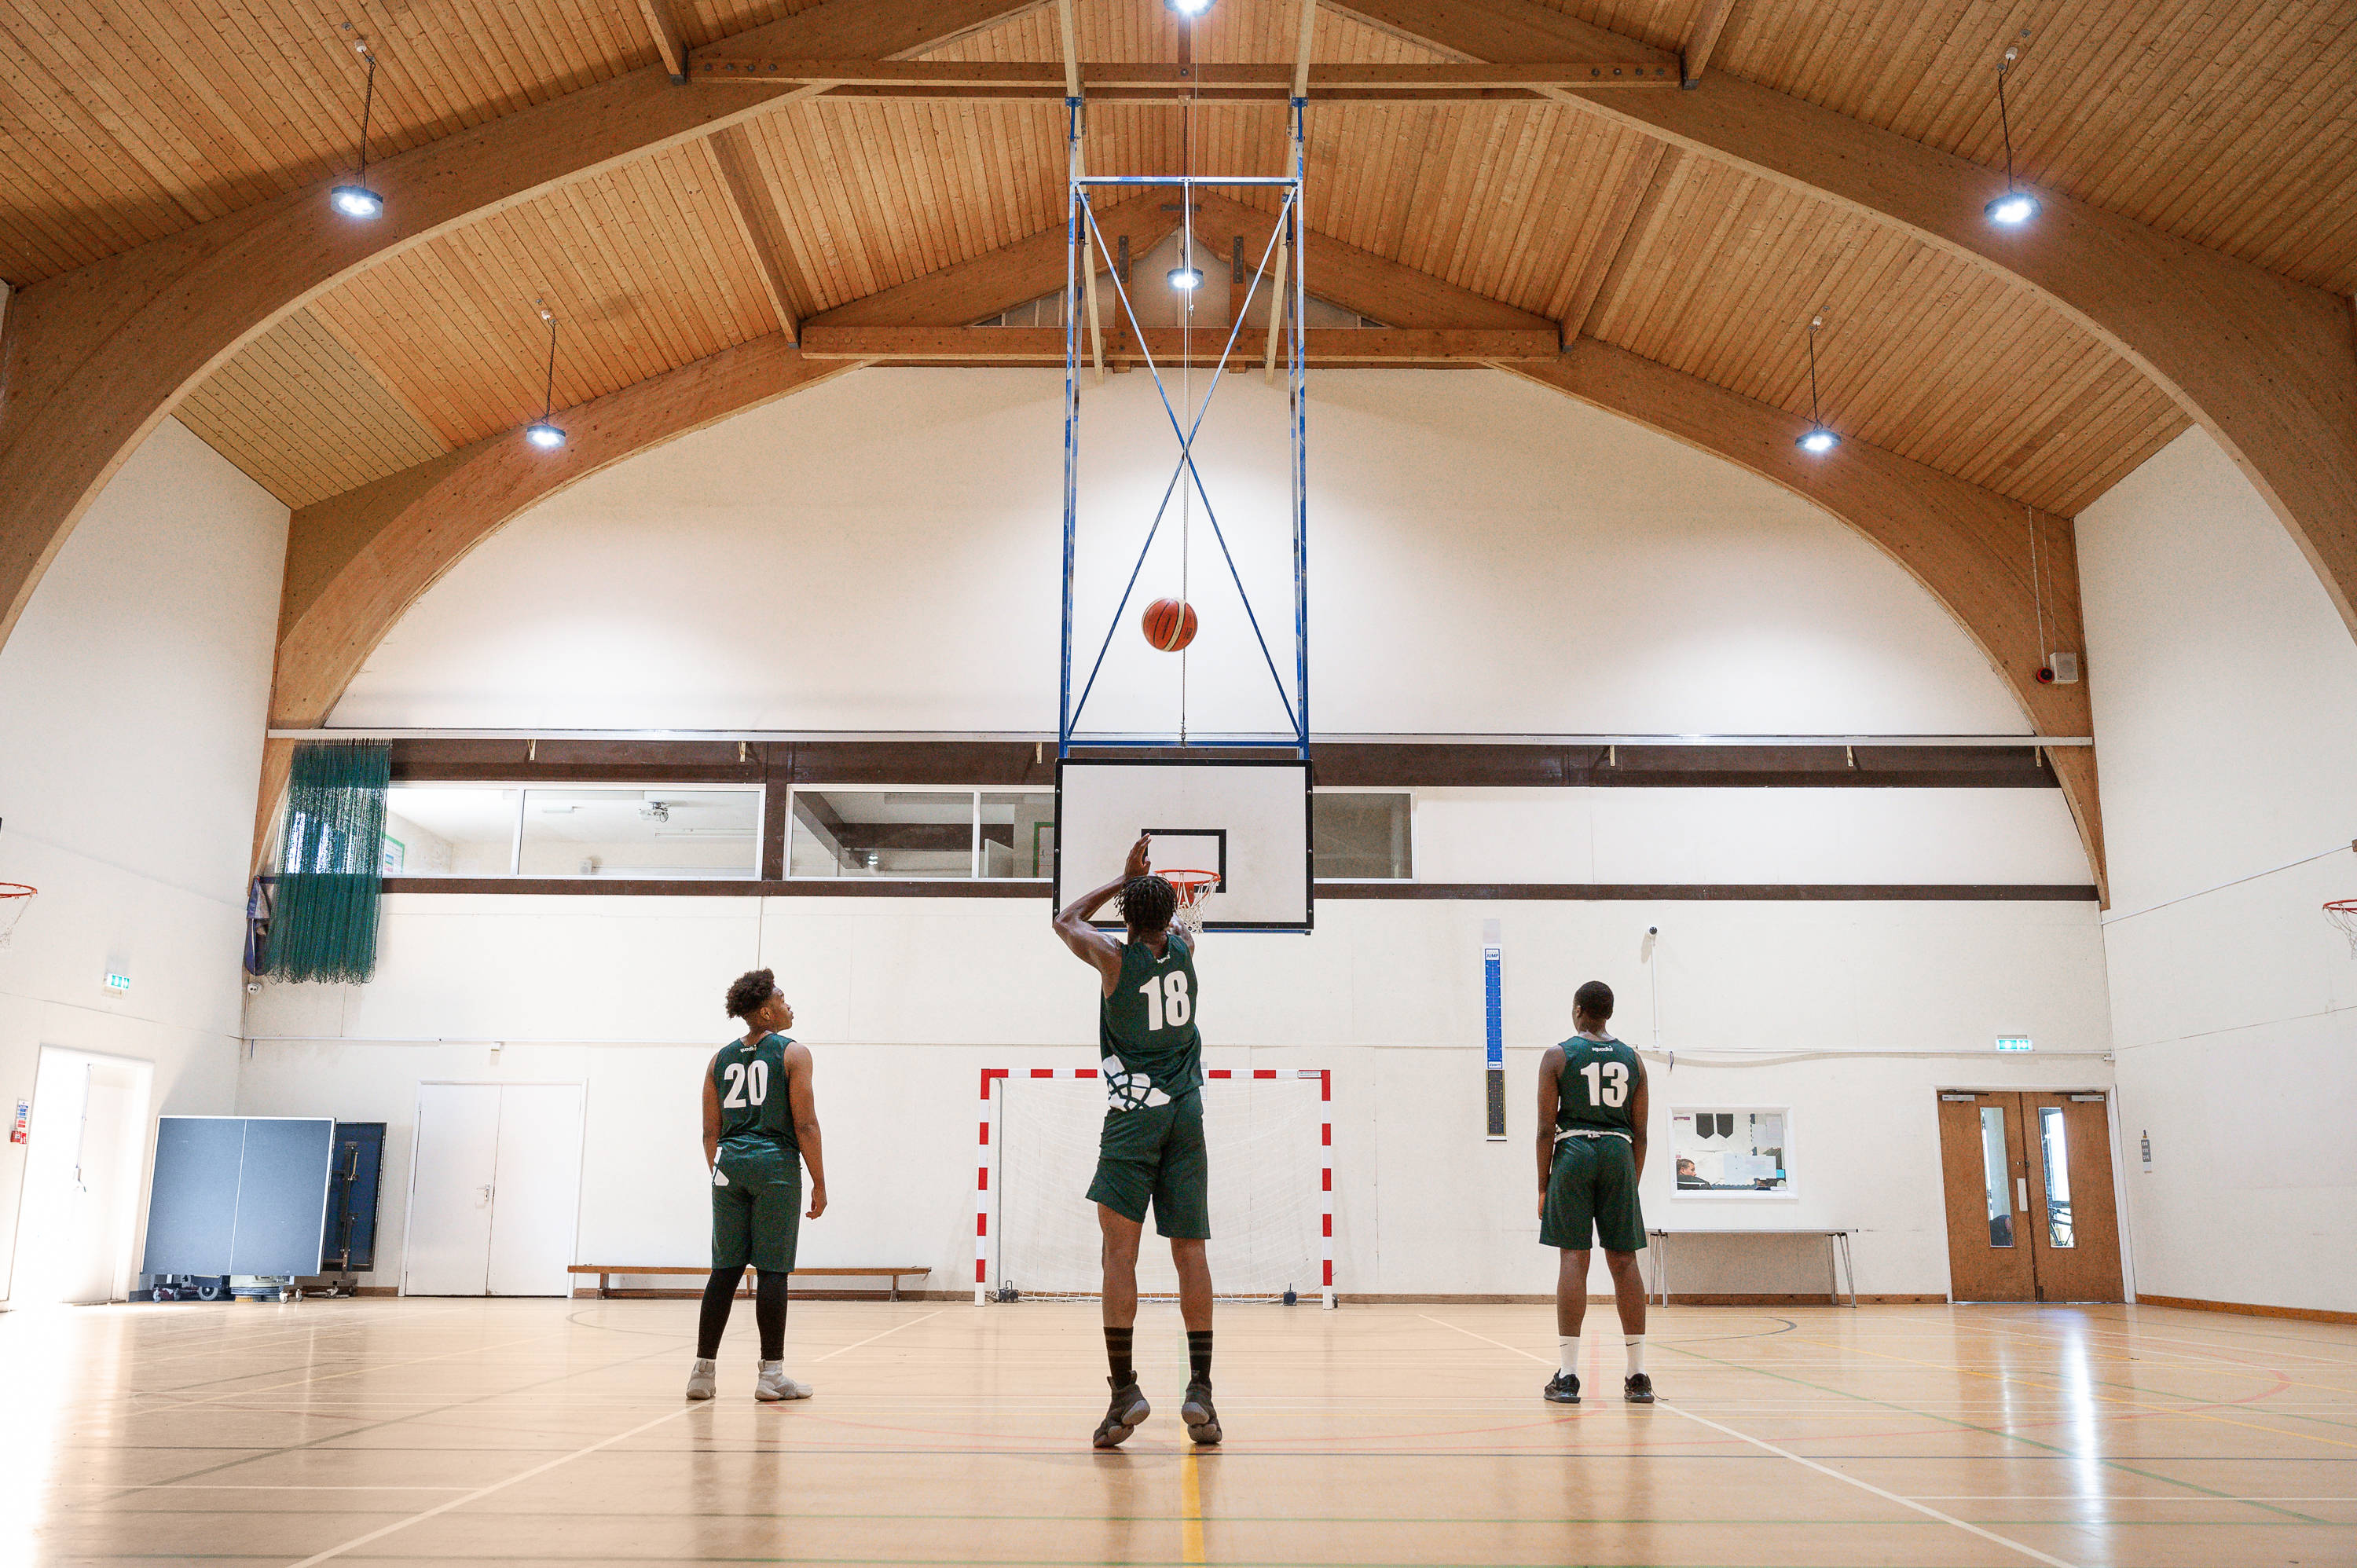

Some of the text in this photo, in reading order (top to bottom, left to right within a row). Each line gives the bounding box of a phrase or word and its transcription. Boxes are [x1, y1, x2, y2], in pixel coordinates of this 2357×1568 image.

[1139, 970, 1190, 1031] 18
[724, 1060, 768, 1108] 20
[1580, 1061, 1629, 1107] 13
